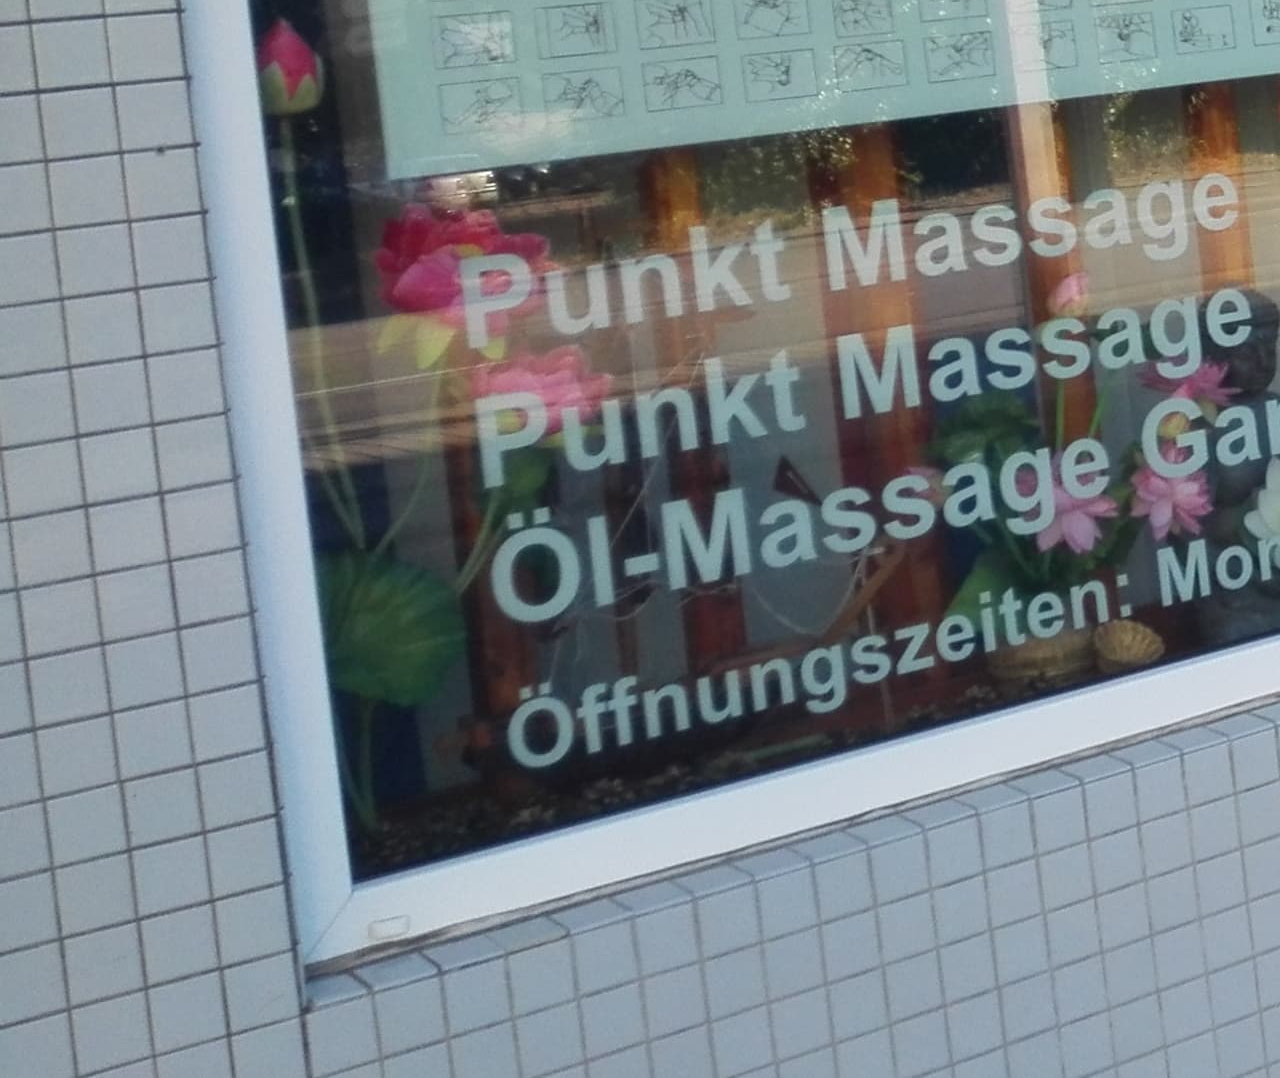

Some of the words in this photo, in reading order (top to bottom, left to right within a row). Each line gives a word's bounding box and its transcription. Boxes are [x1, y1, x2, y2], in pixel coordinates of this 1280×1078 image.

[460, 216, 791, 349] Punkt
[823, 172, 1239, 292] Massage
[474, 354, 805, 490] Punkt
[839, 288, 1252, 420] Massage
[491, 433, 1112, 626] Öl-Massage
[508, 572, 1134, 769] Öffnungszeiten:
